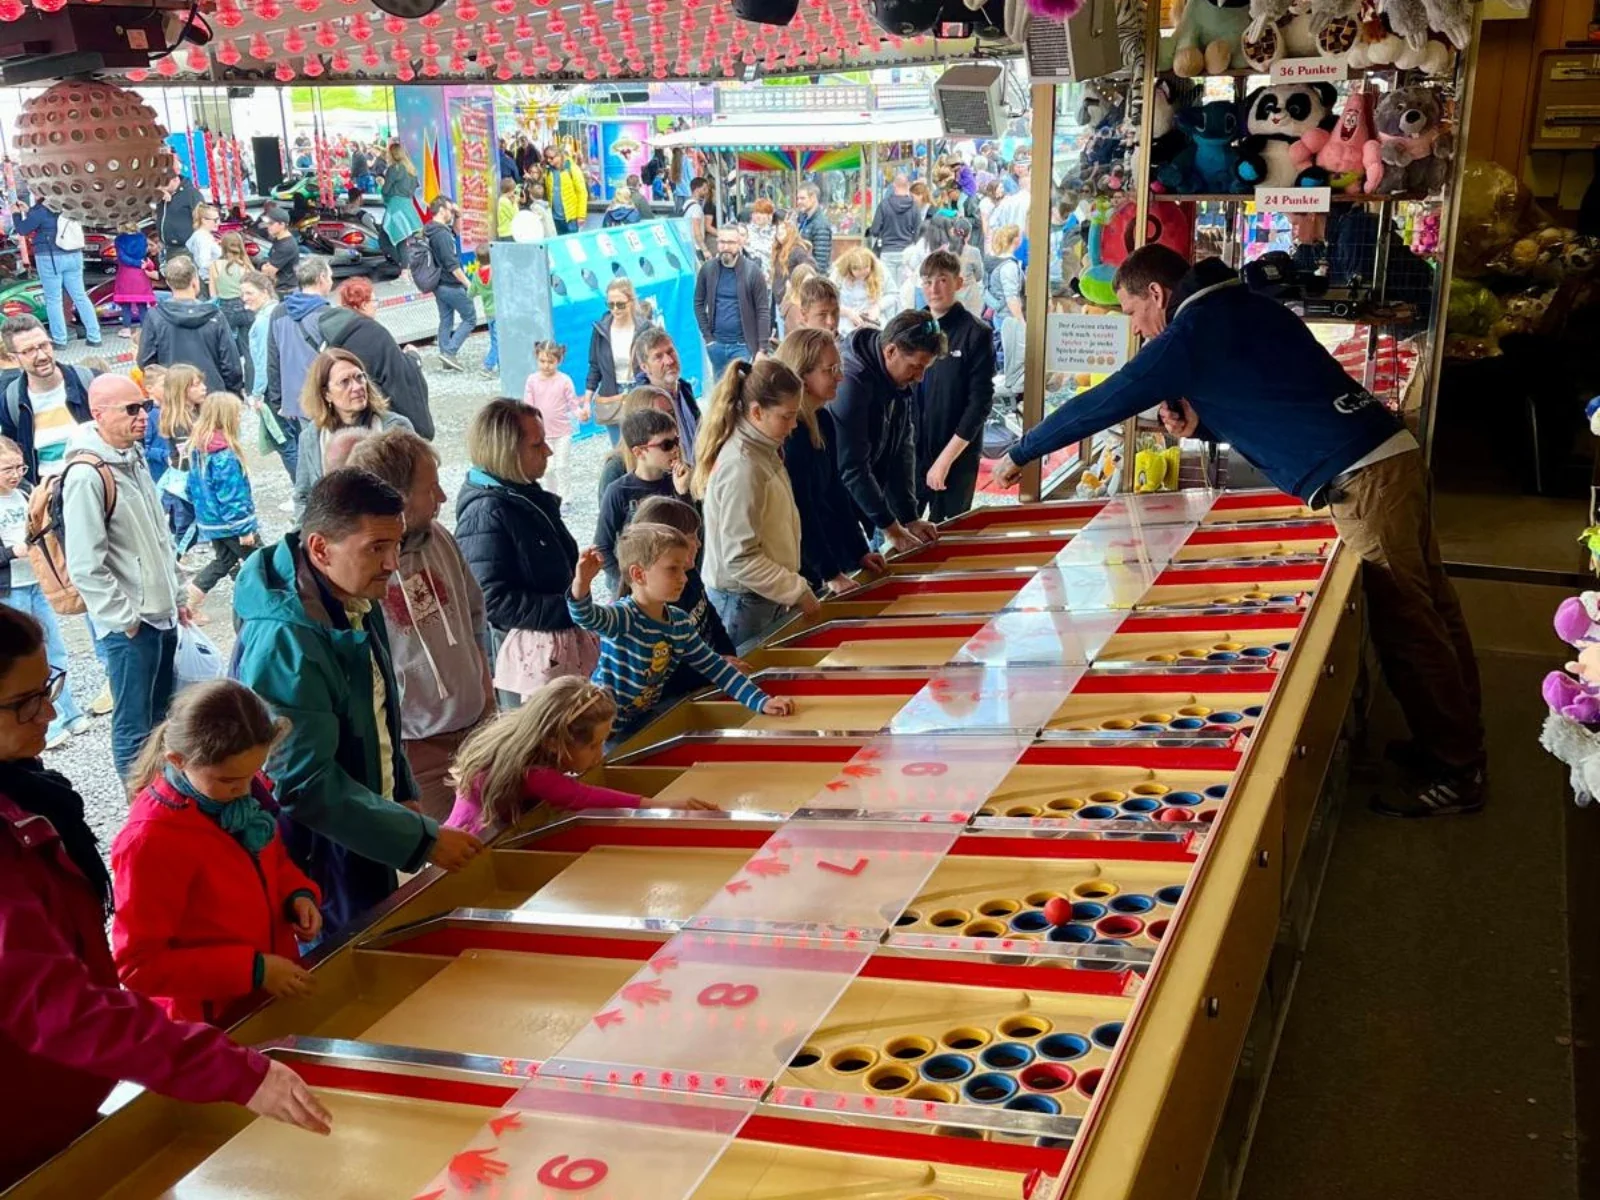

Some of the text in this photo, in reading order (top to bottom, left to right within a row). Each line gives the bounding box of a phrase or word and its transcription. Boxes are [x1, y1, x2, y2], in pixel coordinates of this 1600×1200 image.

[1280, 65, 1338, 76] 36 Punkte
[1264, 195, 1320, 205] 24 Punkte
[817, 858, 869, 877] 7
[697, 983, 759, 1008] 8
[537, 1155, 609, 1191] 9
